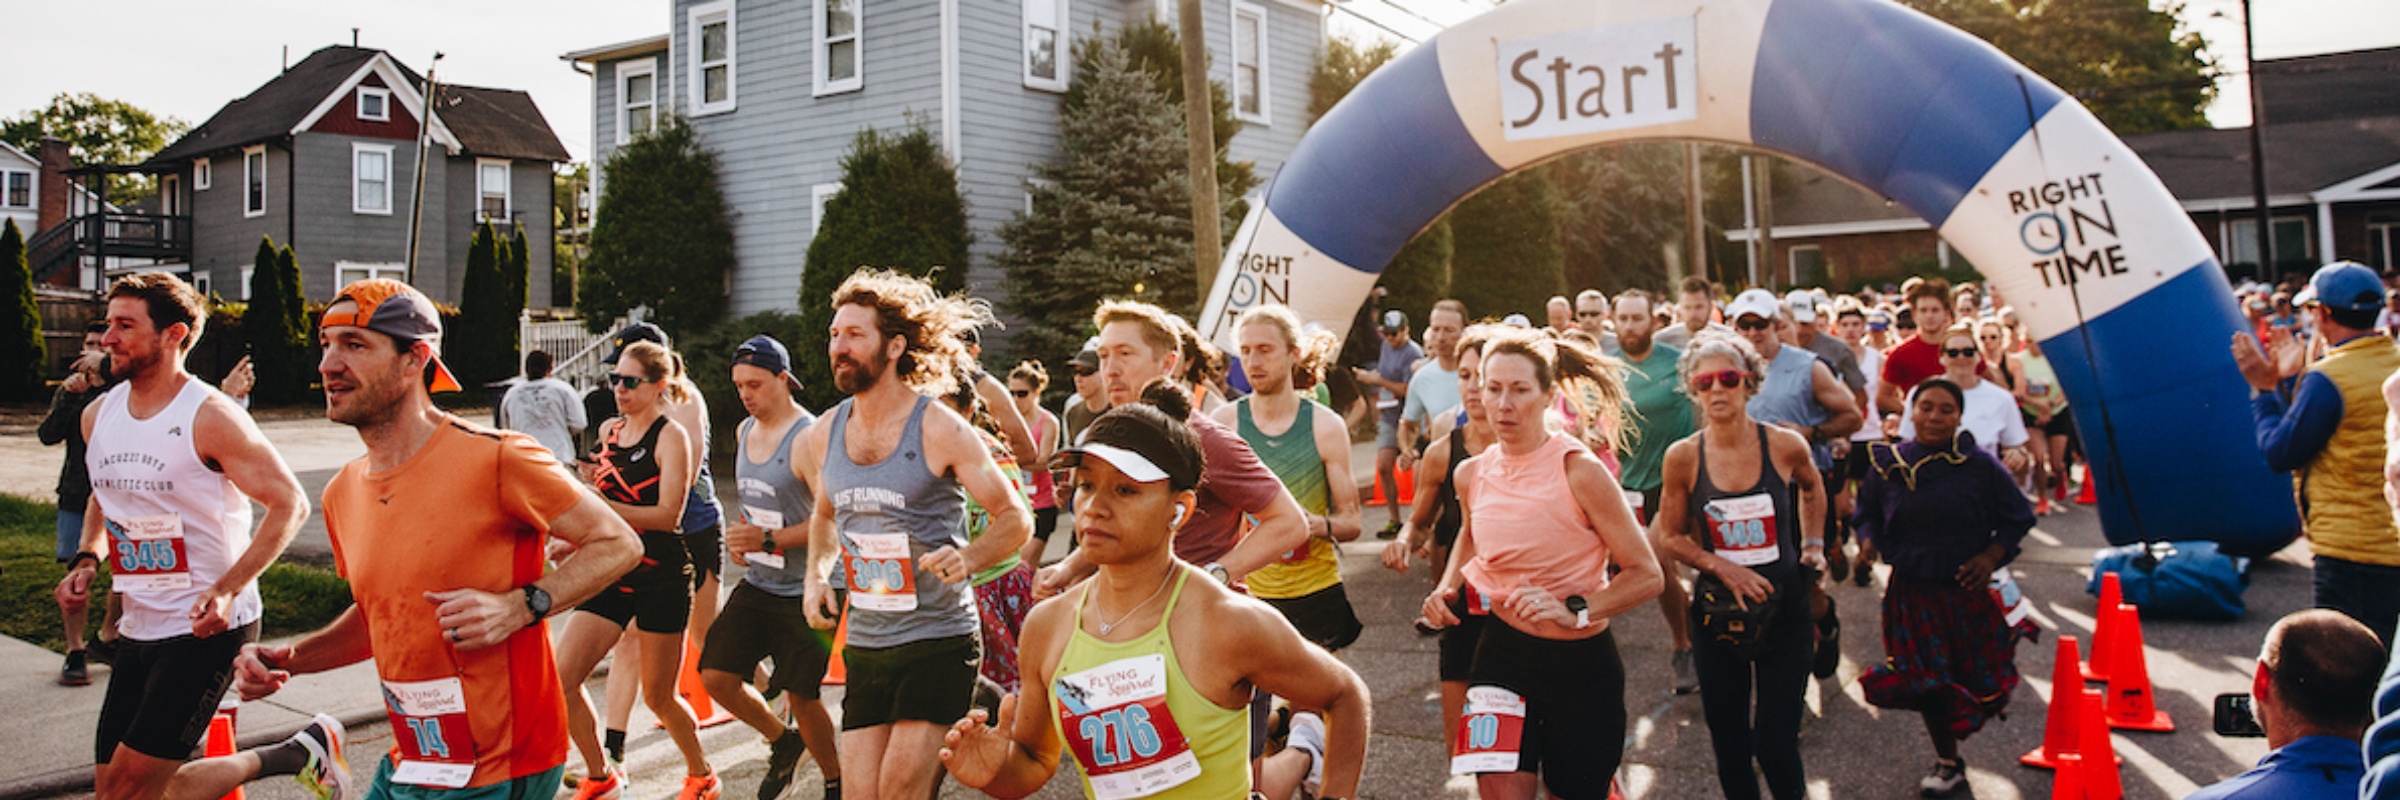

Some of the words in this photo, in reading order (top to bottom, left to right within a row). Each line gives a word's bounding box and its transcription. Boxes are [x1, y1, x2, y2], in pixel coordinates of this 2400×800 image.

[1511, 43, 1683, 128] Start
[2008, 173, 2102, 214] RIGHT
[2019, 200, 2118, 254] ON
[2032, 245, 2129, 288] TIME
[94, 479, 141, 491] ATHLETIC
[144, 481, 174, 491] CLUB
[855, 487, 905, 509] RUNNING
[1718, 519, 1766, 548] 148
[117, 541, 175, 571] 345
[1089, 669, 1137, 689] FLYING
[405, 716, 450, 758] 14
[1080, 703, 1162, 767] 276
[1468, 714, 1499, 749] 10
